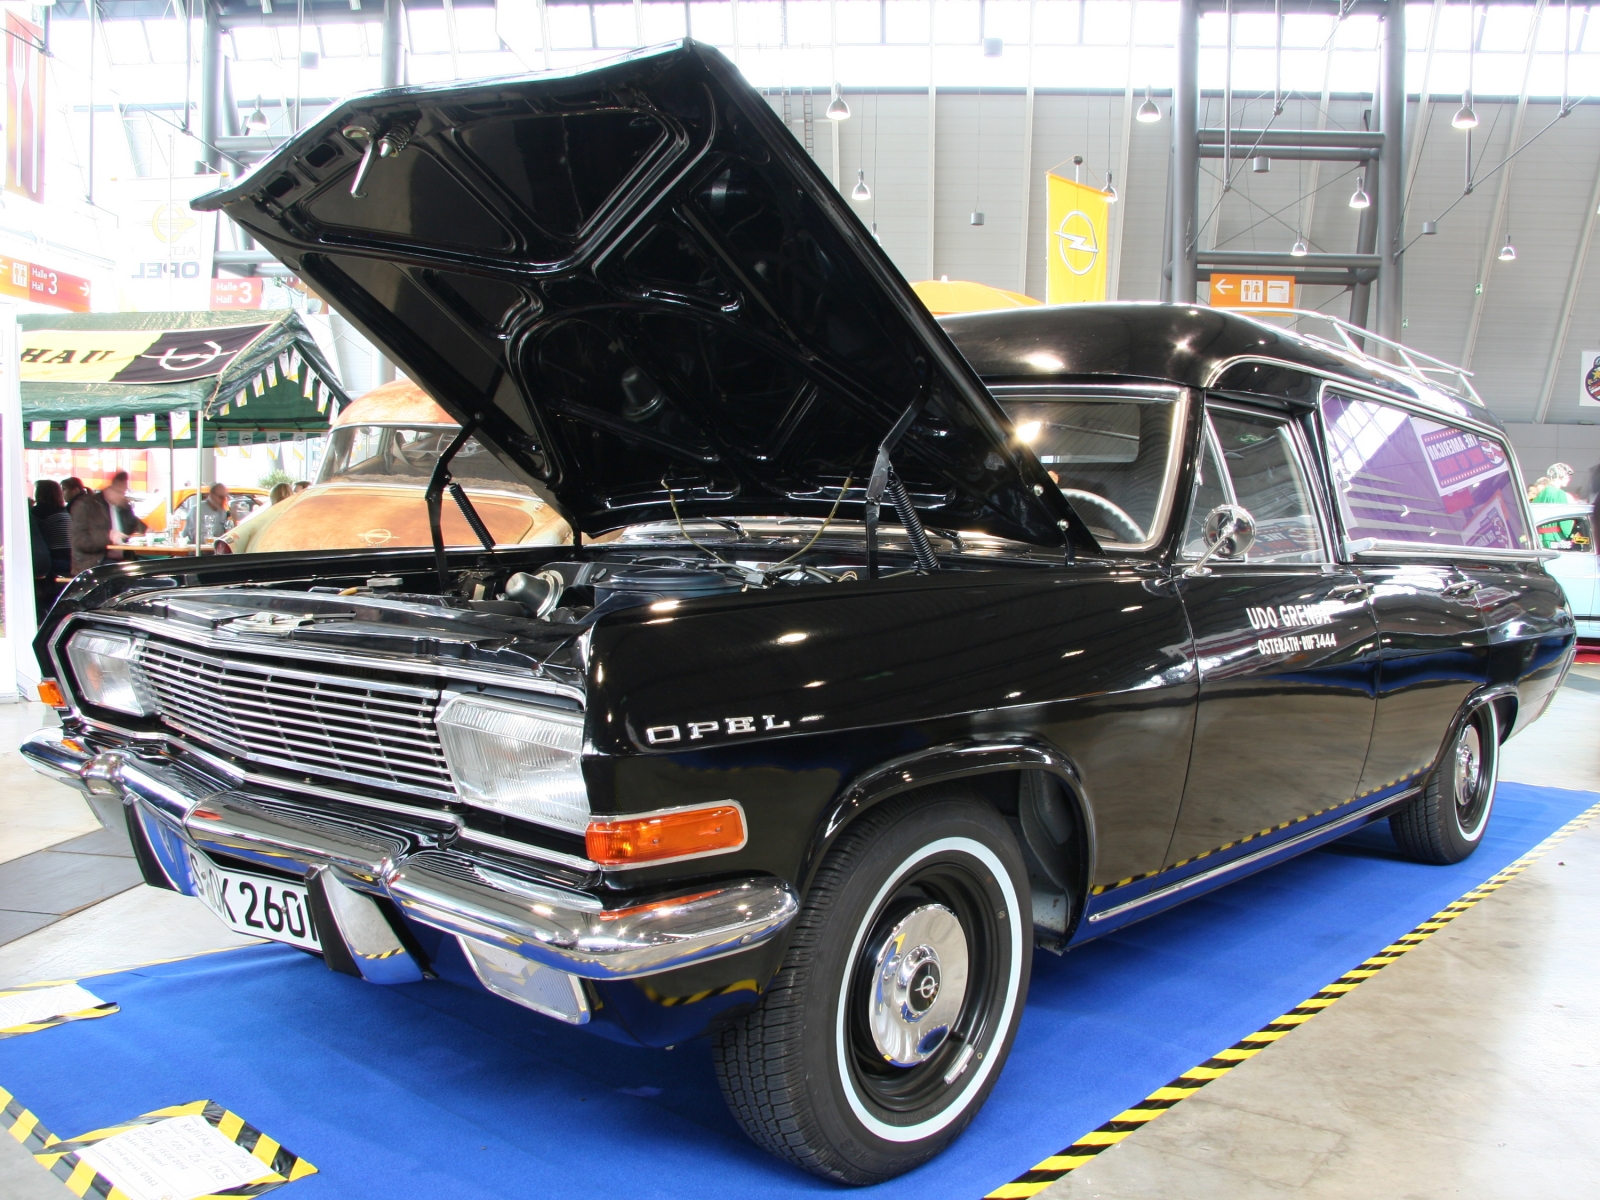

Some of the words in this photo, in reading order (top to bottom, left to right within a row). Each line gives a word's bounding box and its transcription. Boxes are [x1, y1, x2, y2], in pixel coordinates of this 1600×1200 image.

[32, 267, 48, 280] Halle
[48, 272, 58, 295] 3
[31, 281, 44, 292] Hall
[216, 282, 238, 291] Halle
[239, 281, 252, 304] 3
[216, 294, 232, 304] Hall
[1246, 606, 1279, 629] UDO
[646, 714, 791, 745] OPEL
[189, 852, 205, 896] S
